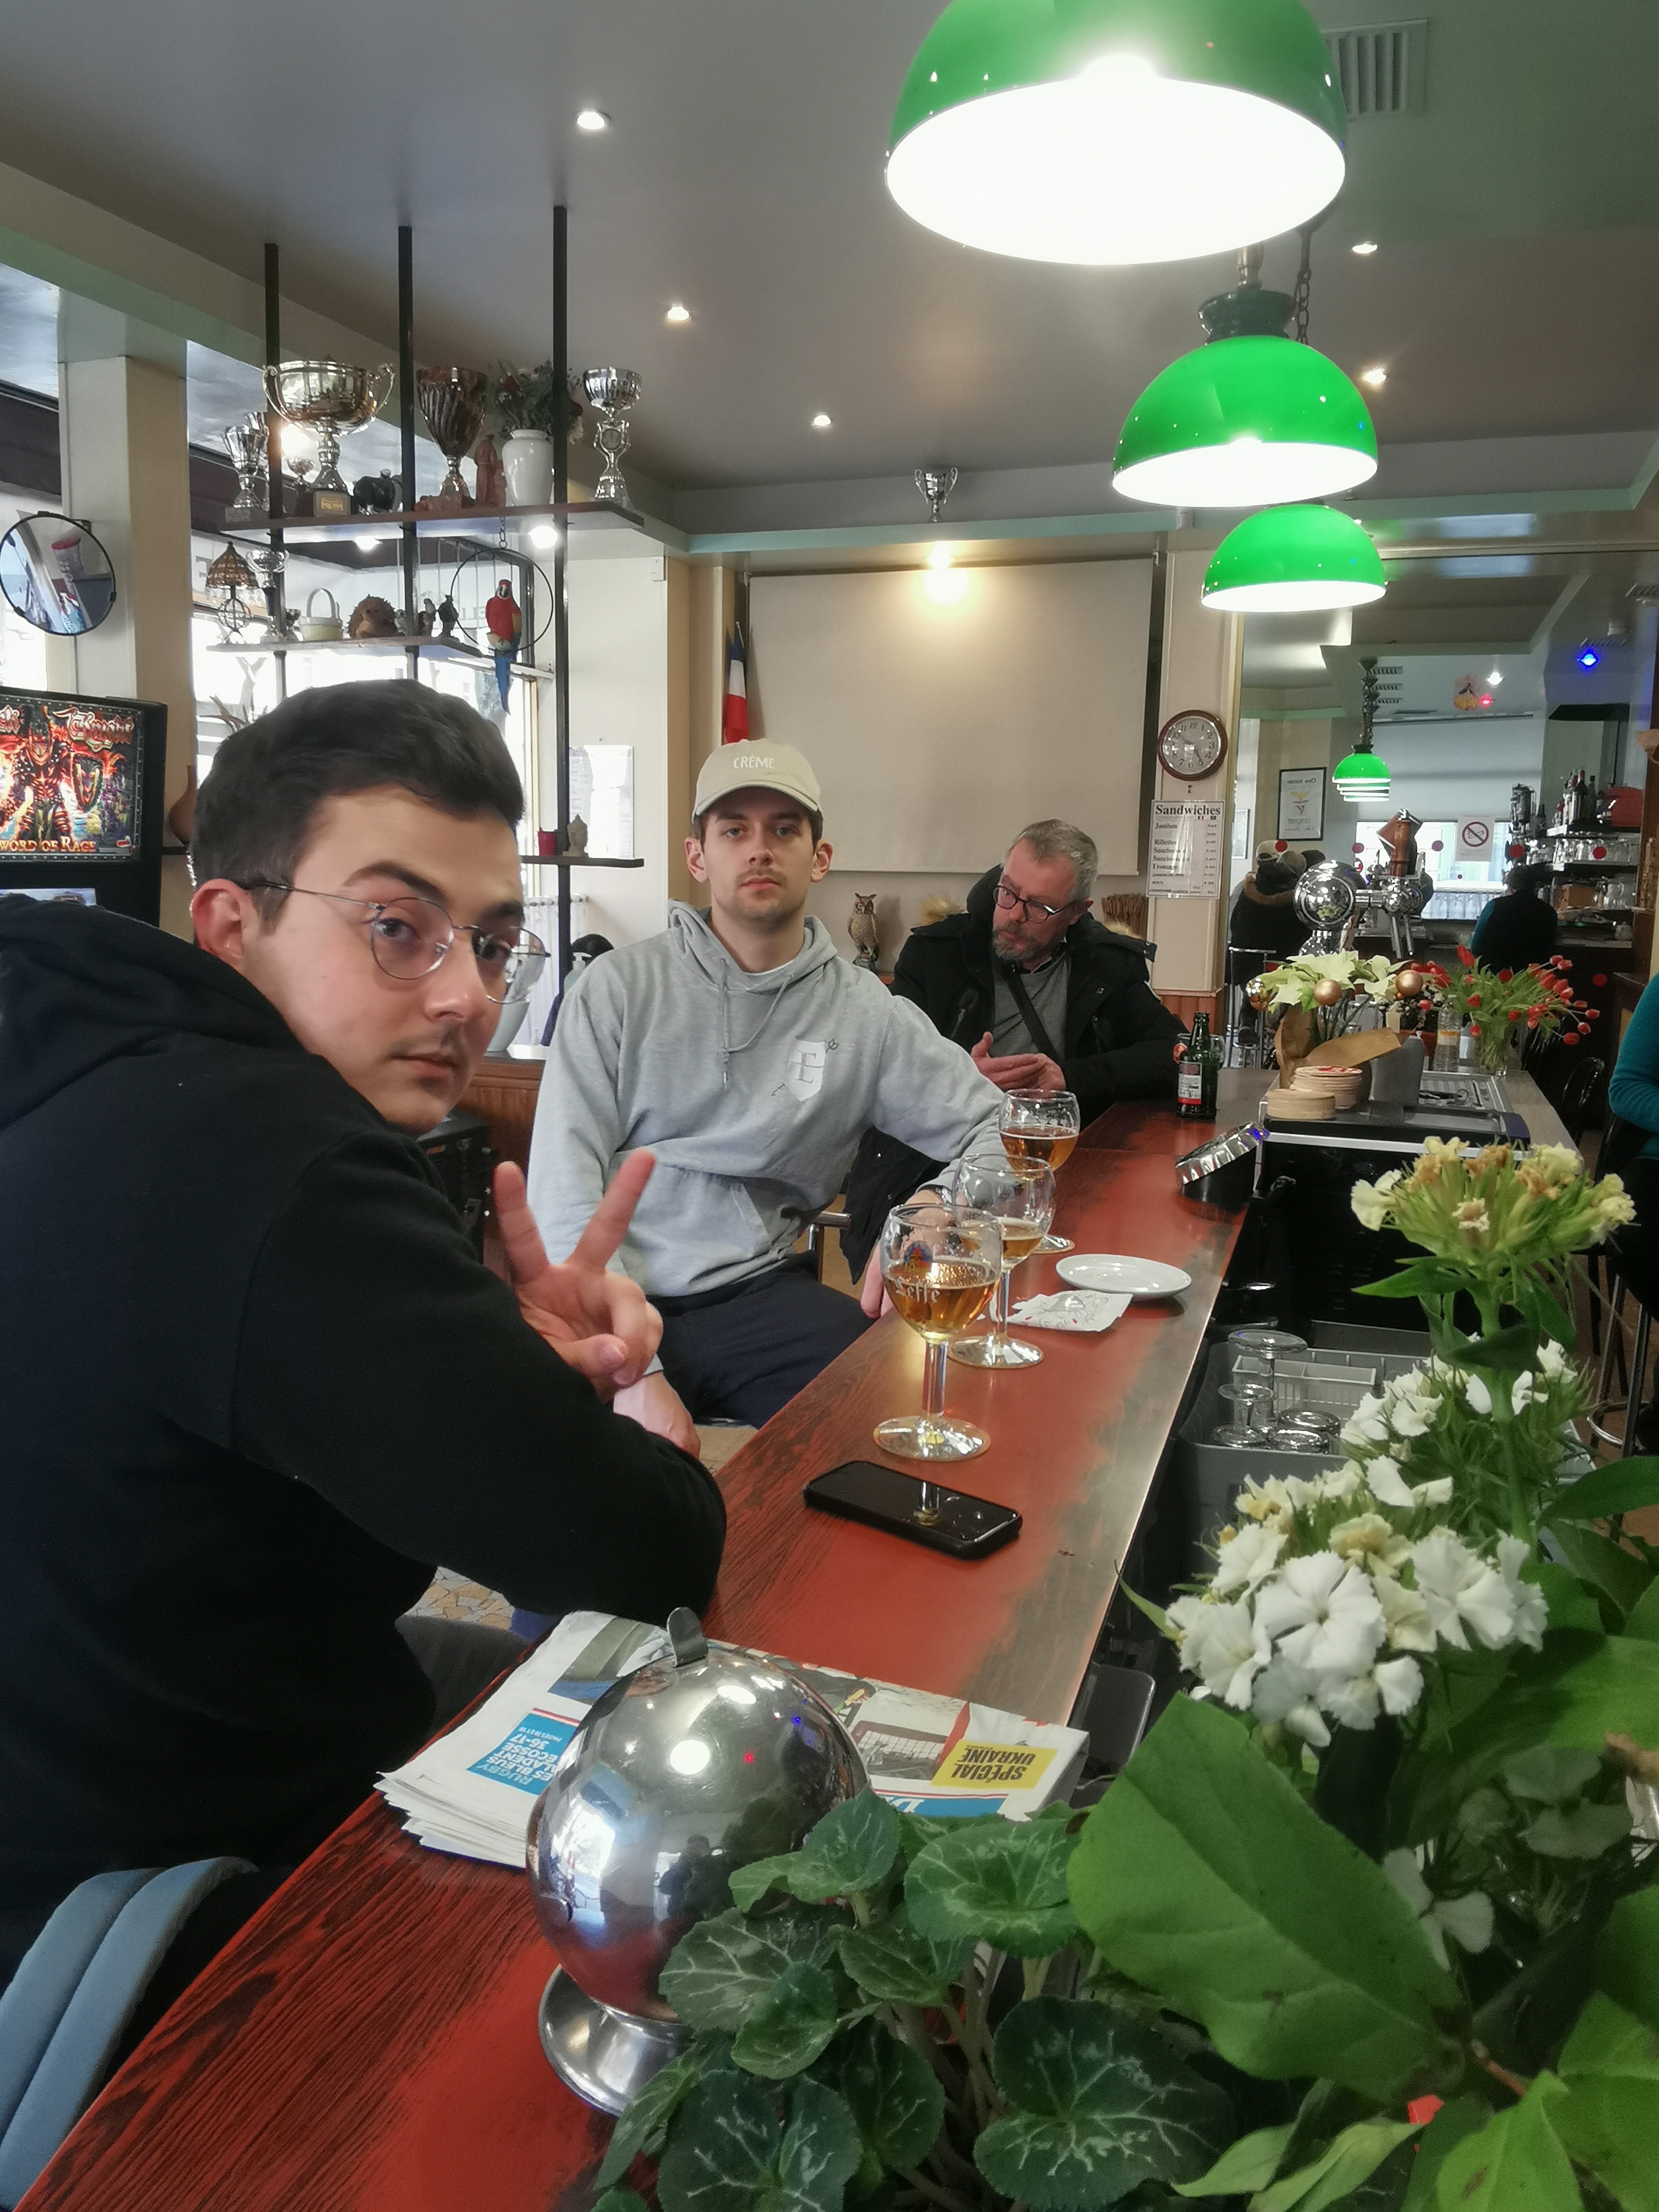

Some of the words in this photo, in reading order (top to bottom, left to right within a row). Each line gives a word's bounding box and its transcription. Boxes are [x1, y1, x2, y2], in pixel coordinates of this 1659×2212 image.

[733, 753, 775, 769] CRÈME
[1155, 804, 1221, 815] Sandwiches
[0, 840, 37, 852] WORD
[895, 1275, 940, 1304] Leffe
[509, 1733, 550, 1750] 36-17
[493, 1750, 557, 1774] ALADENT
[502, 1742, 559, 1763] ECOSSE
[957, 1748, 1036, 1766] UKRAINE
[476, 1764, 534, 1786] RUGBY
[486, 1756, 534, 1776] BLEUS
[951, 1763, 1027, 1783] SPÉCIAL
[532, 1770, 553, 1782] ES
